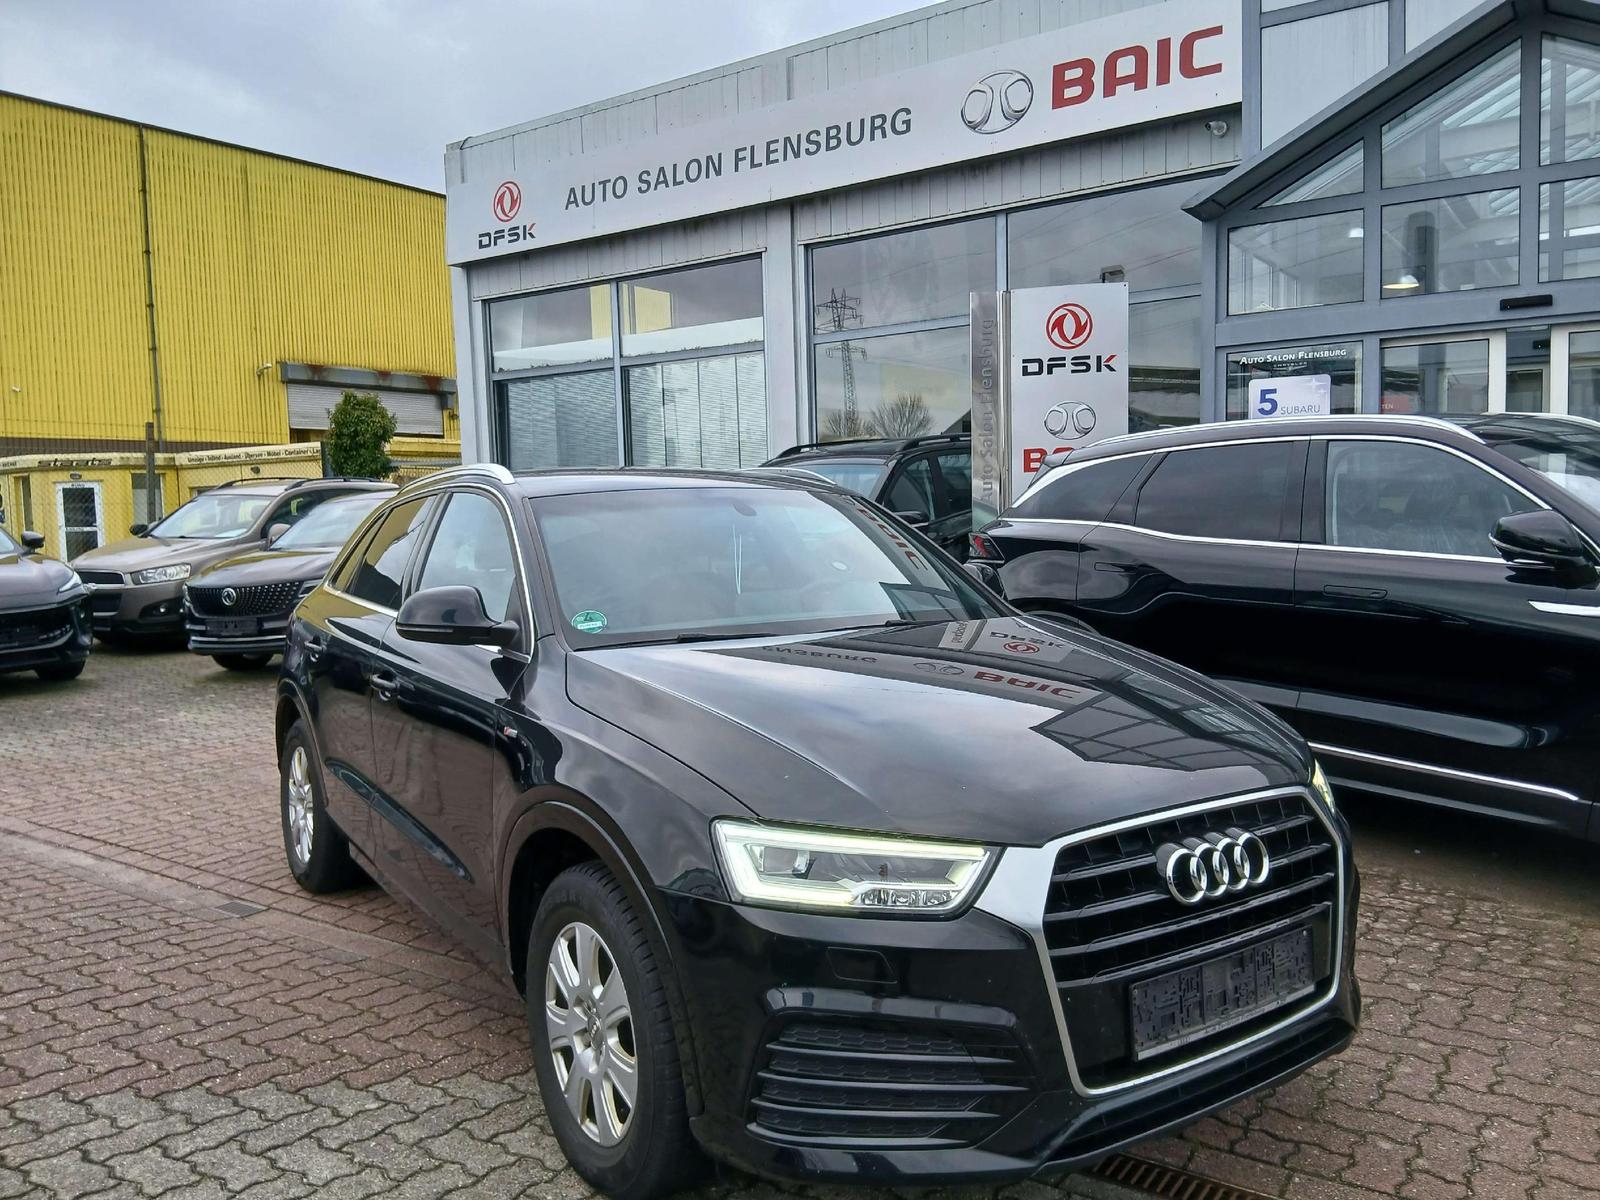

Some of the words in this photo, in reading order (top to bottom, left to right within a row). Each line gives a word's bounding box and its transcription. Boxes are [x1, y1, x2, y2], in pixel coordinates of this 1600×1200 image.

[1051, 24, 1224, 111] BAIC
[564, 174, 629, 211] AUTO
[636, 151, 723, 195] SALON
[733, 106, 914, 174] FLENSBURG
[478, 222, 537, 250] DFSK
[977, 318, 995, 405] Flensburg
[1021, 354, 1119, 377] DFSK
[1266, 353, 1296, 363] SALON
[1298, 348, 1347, 360] FLENSBURG
[1257, 388, 1279, 416] 5
[1280, 404, 1321, 415] SUBARU
[978, 409, 995, 459] Salon
[284, 447, 309, 456] Container
[980, 465, 995, 504] Auto
